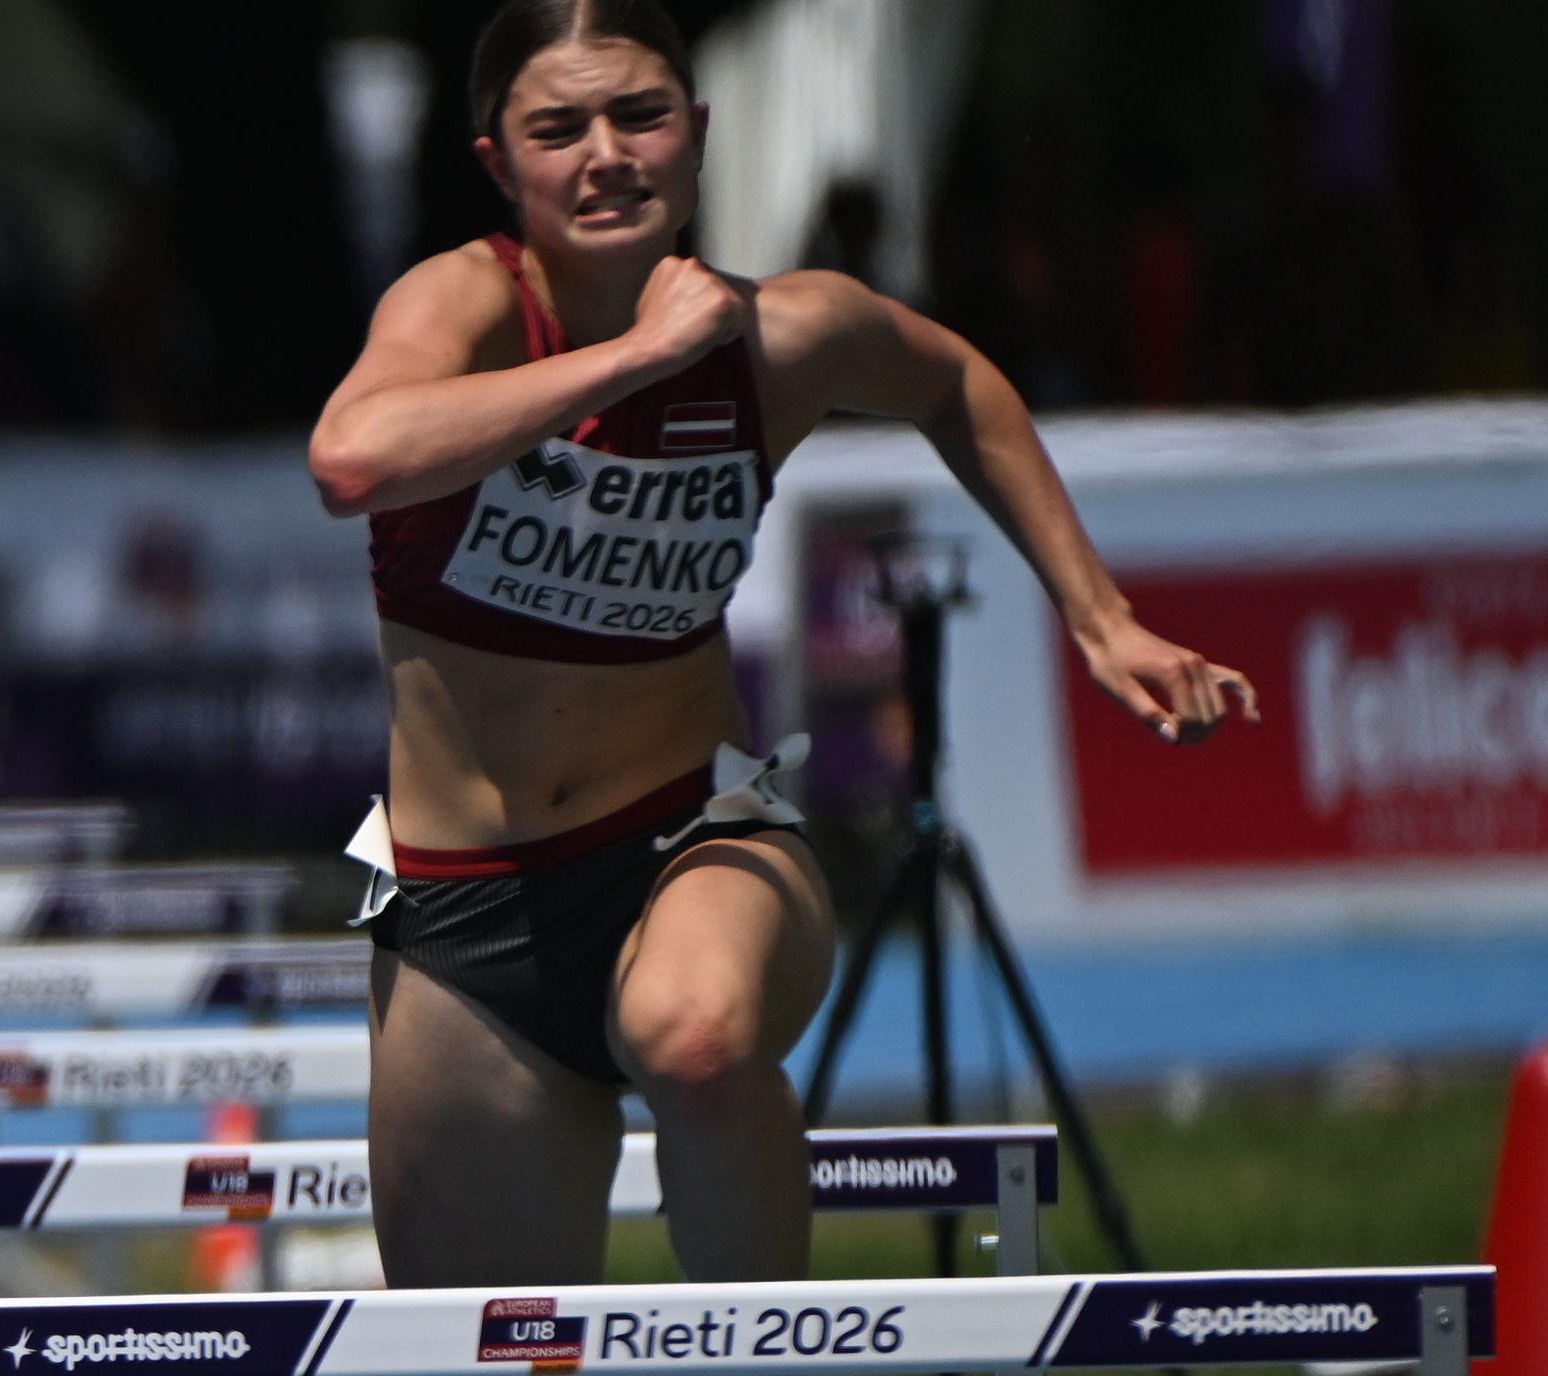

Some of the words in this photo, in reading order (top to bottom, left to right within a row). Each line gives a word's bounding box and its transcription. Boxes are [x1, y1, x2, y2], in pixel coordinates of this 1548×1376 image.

[468, 504, 746, 593] FOMENKO
[491, 574, 596, 621] RIETI
[601, 602, 698, 633] 2026
[287, 1162, 369, 1209] Rie
[512, 1321, 556, 1341] U18
[600, 1306, 739, 1360] Rieti
[753, 1305, 907, 1356] 2026
[1169, 1301, 1379, 1345] sportissimo
[42, 1327, 250, 1371] sportissimo
[483, 1347, 580, 1359] CHAMPIONSHIPS
